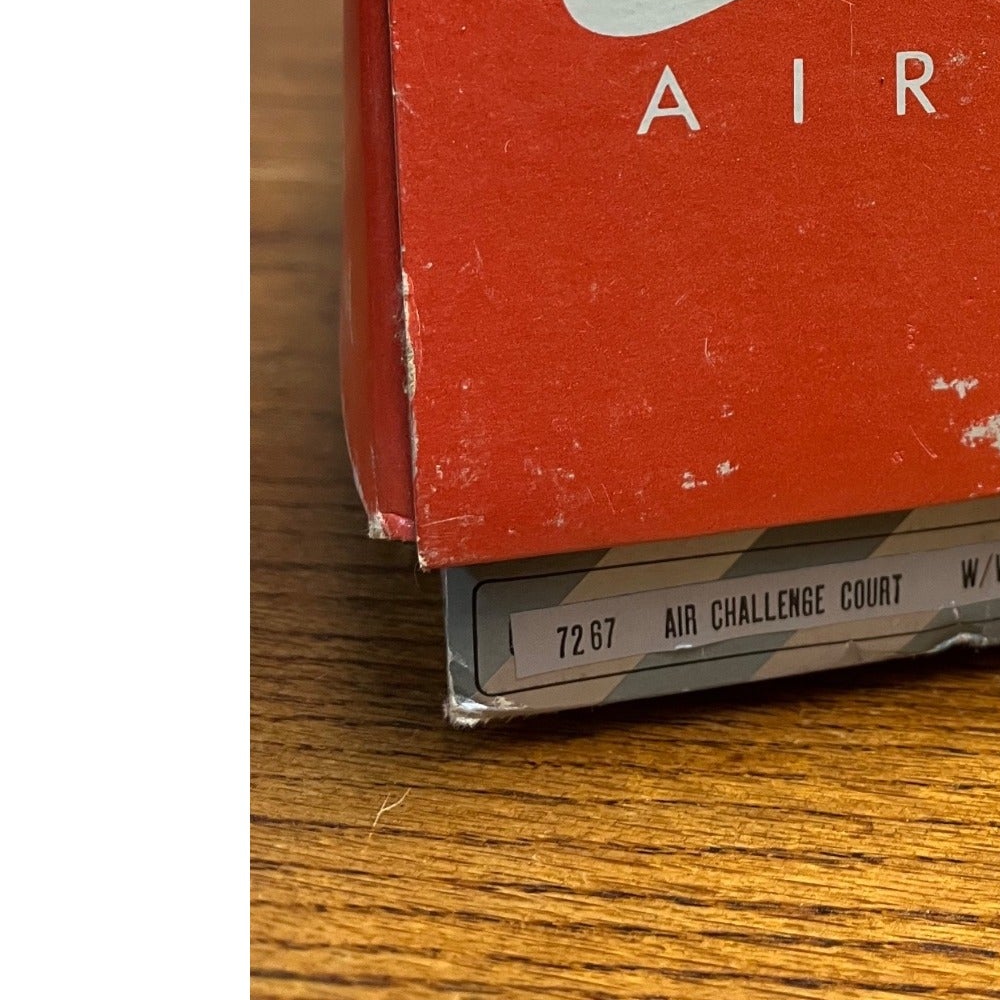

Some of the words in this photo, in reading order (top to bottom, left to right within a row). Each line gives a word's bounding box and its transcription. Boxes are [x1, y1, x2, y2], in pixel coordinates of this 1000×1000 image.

[637, 51, 937, 135] AIR
[556, 617, 616, 658] 7267
[664, 604, 698, 639] AIR
[711, 584, 826, 631] CHALLENGE
[840, 573, 903, 611] COURT
